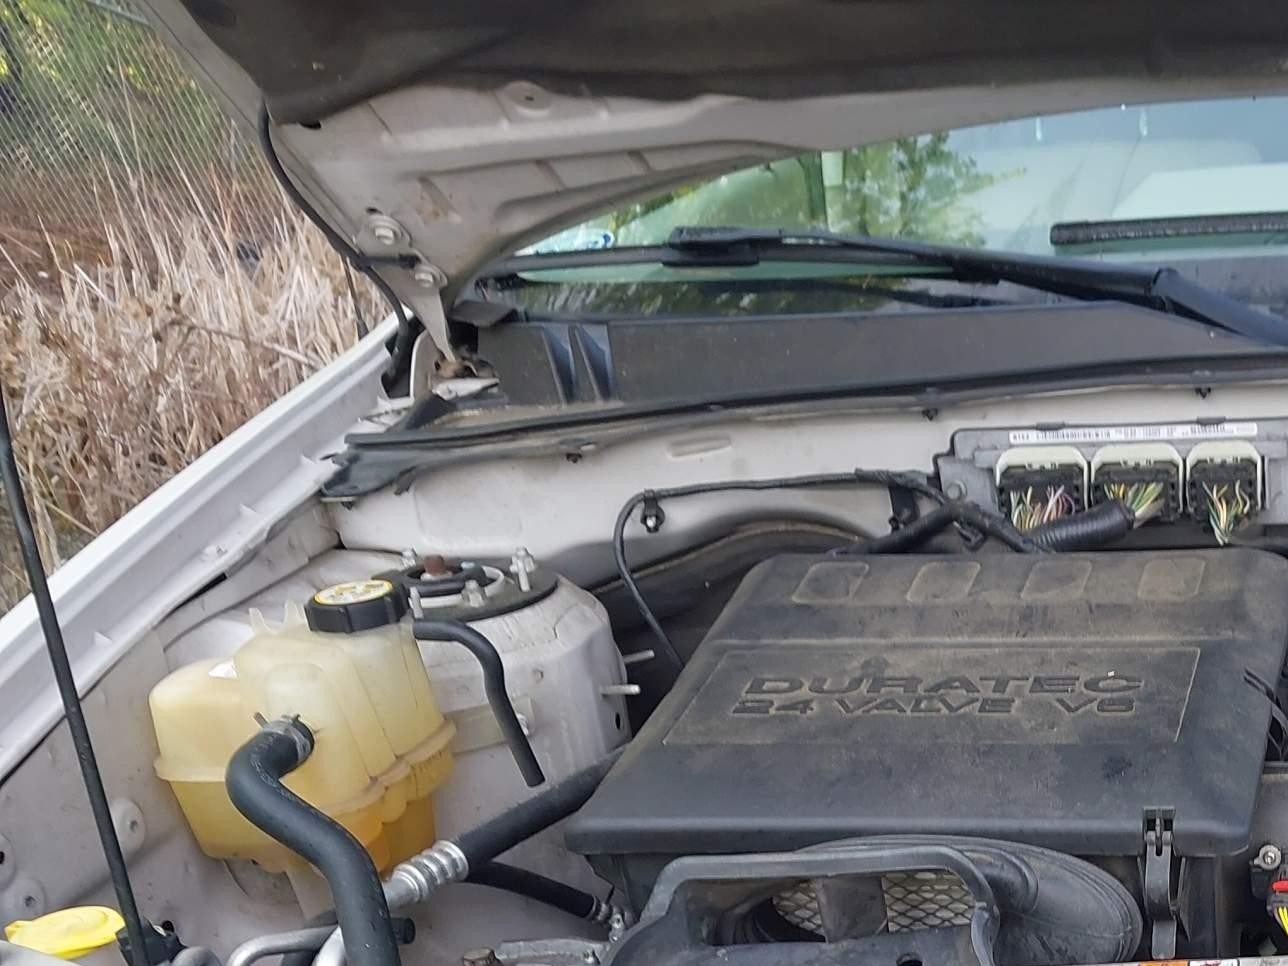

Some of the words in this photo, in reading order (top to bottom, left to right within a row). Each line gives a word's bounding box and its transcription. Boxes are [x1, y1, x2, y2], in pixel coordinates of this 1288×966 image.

[744, 675, 1143, 695] DURATEC
[731, 699, 815, 716] 24
[833, 698, 1017, 716] VALVE
[1054, 697, 1136, 715] V6
